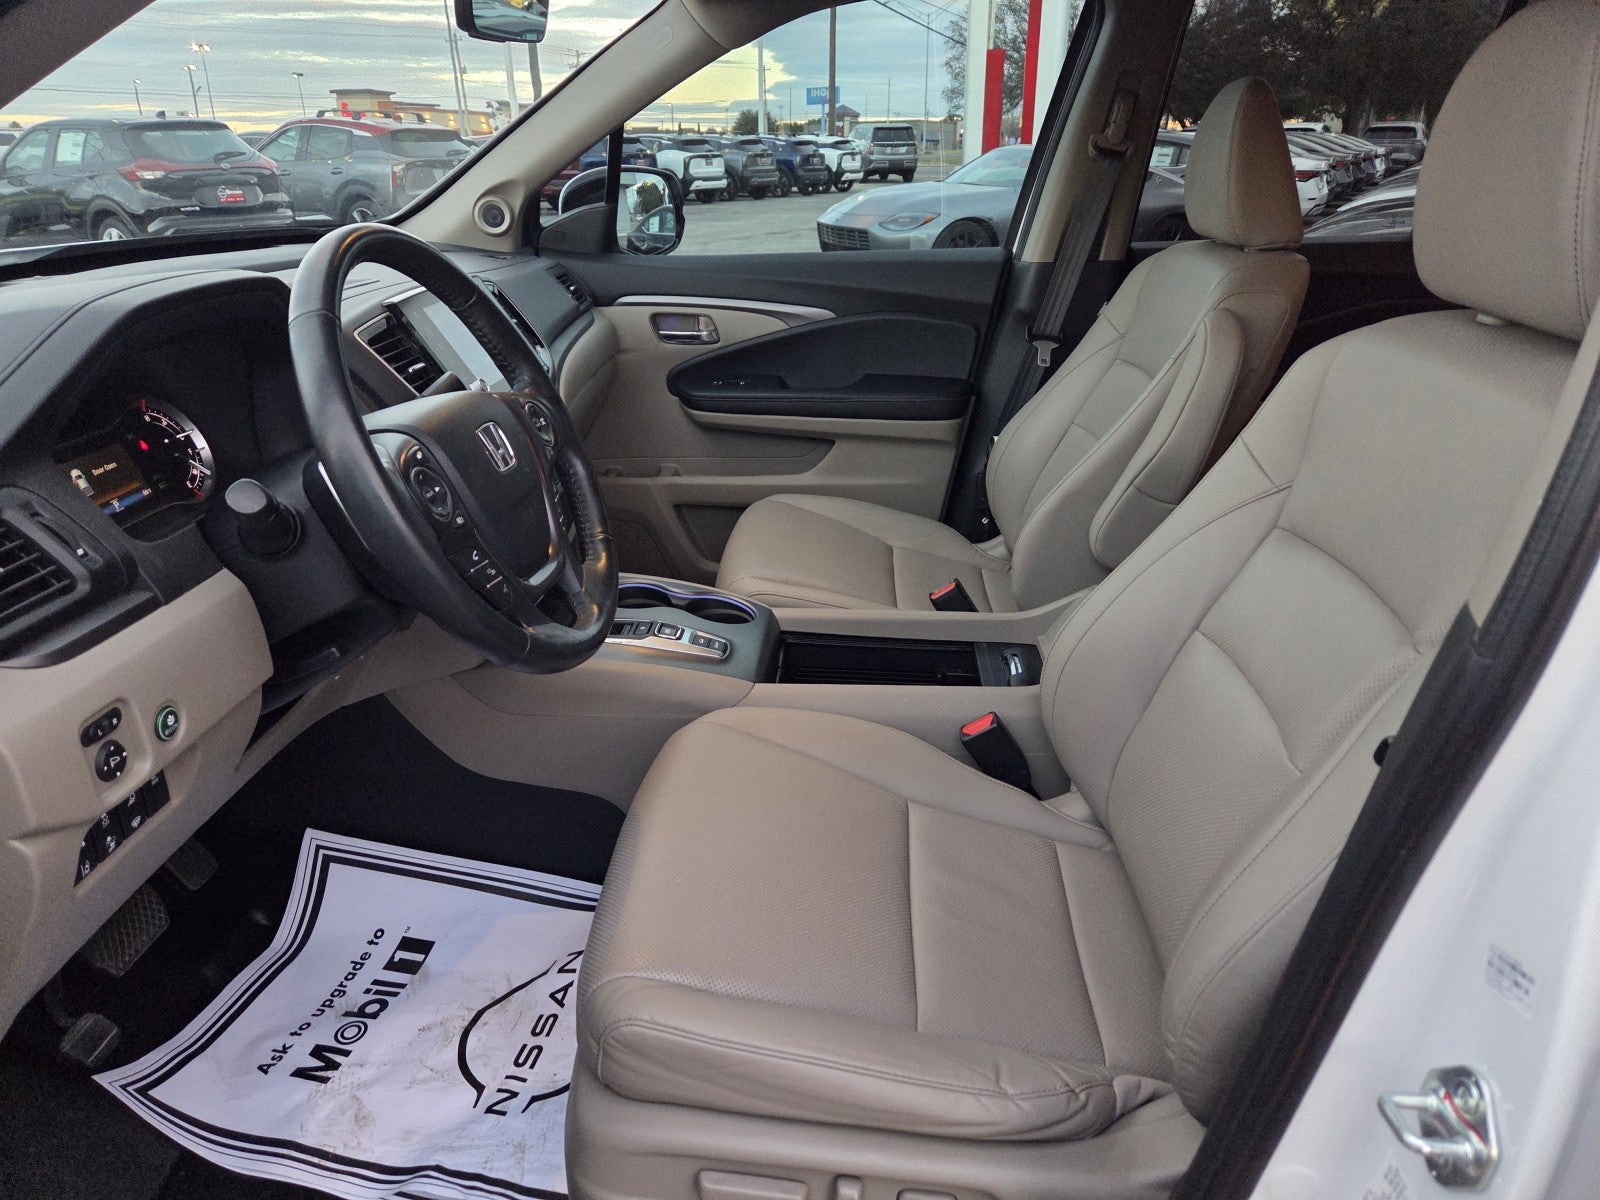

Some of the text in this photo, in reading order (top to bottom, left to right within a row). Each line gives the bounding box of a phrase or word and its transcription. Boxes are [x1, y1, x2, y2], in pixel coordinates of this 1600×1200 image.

[257, 928, 385, 1075] Ask to upgrade to
[289, 976, 408, 1084] Mobil
[484, 949, 584, 1117] NISSAN
